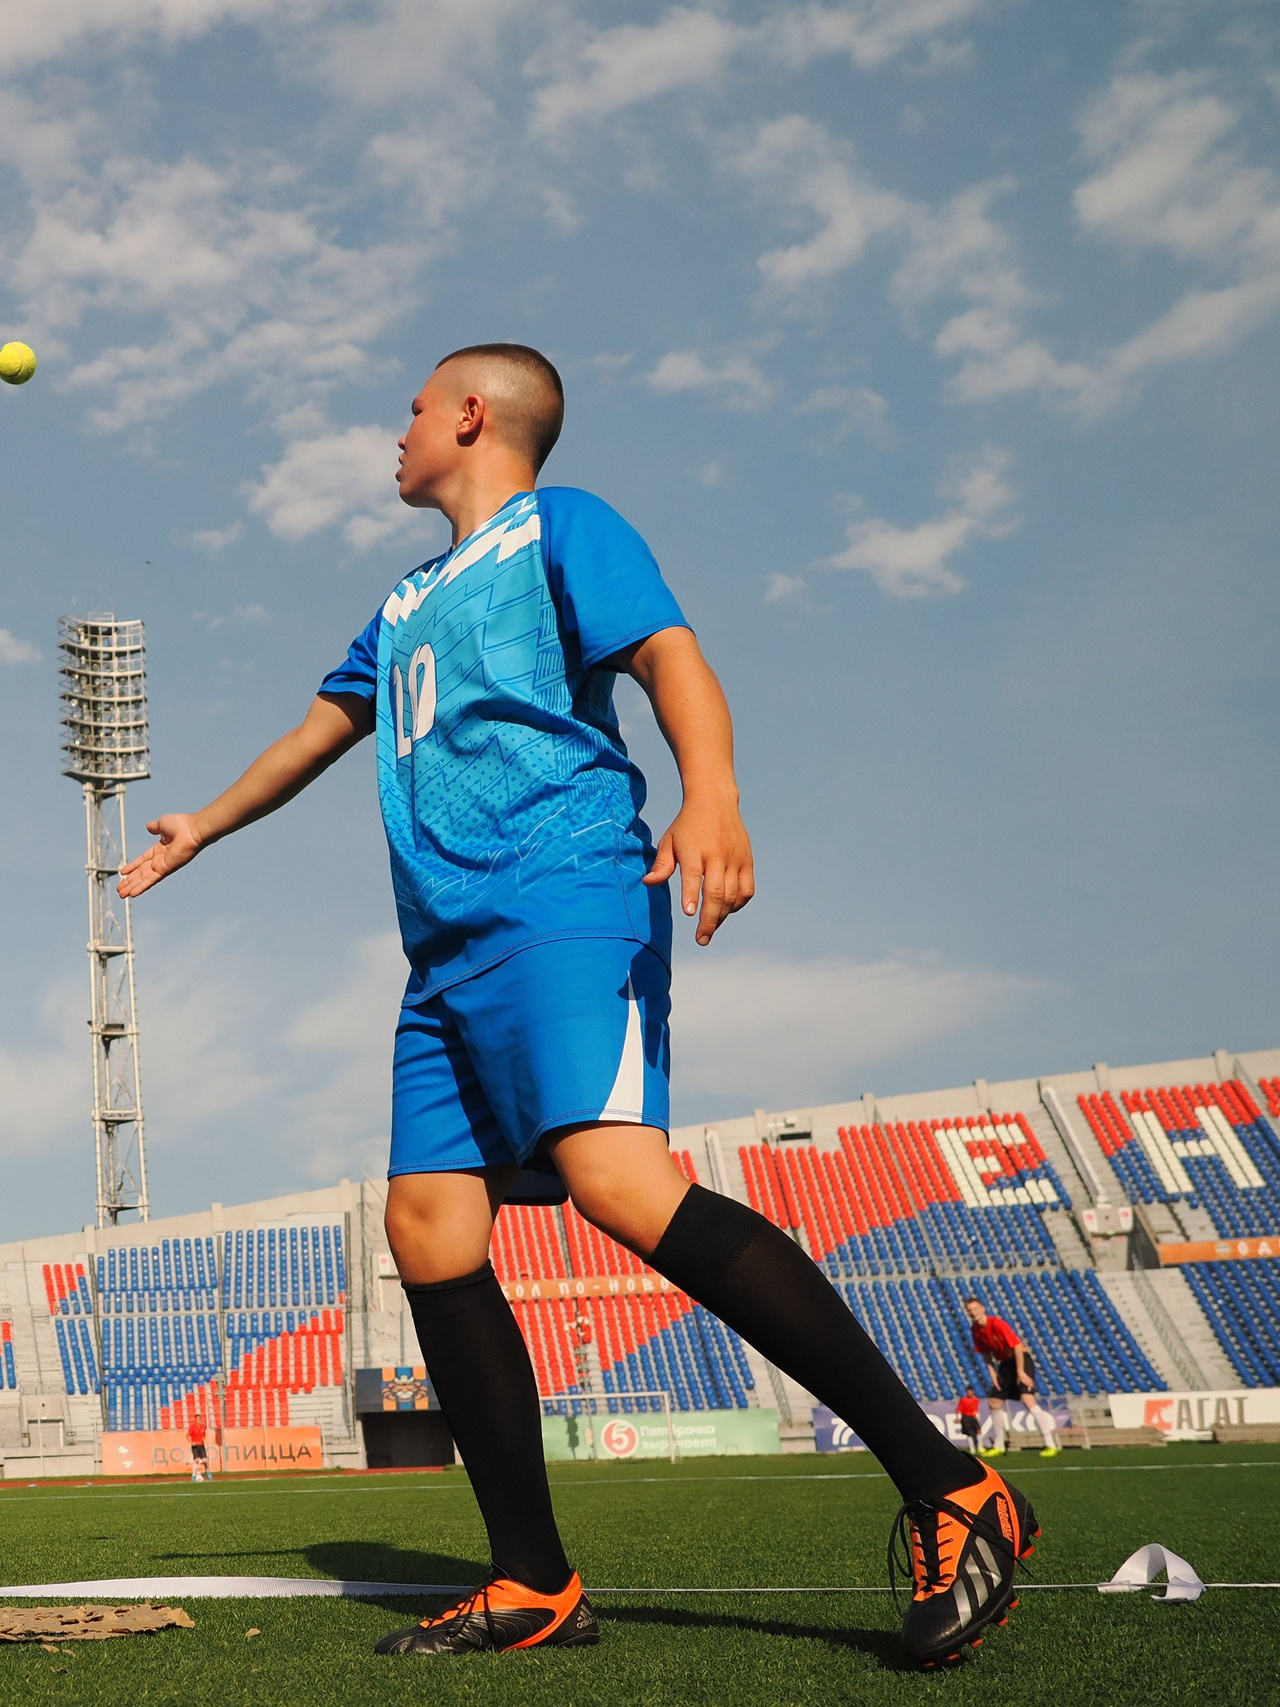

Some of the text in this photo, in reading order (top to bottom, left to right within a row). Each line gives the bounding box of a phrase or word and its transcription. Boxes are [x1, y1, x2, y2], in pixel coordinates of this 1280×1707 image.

[393, 642, 437, 760] 10
[1176, 1396, 1248, 1431] АГАТ
[154, 1443, 312, 1466] ДОО ПИЦЦА
[642, 1438, 717, 1451] вырчает!
